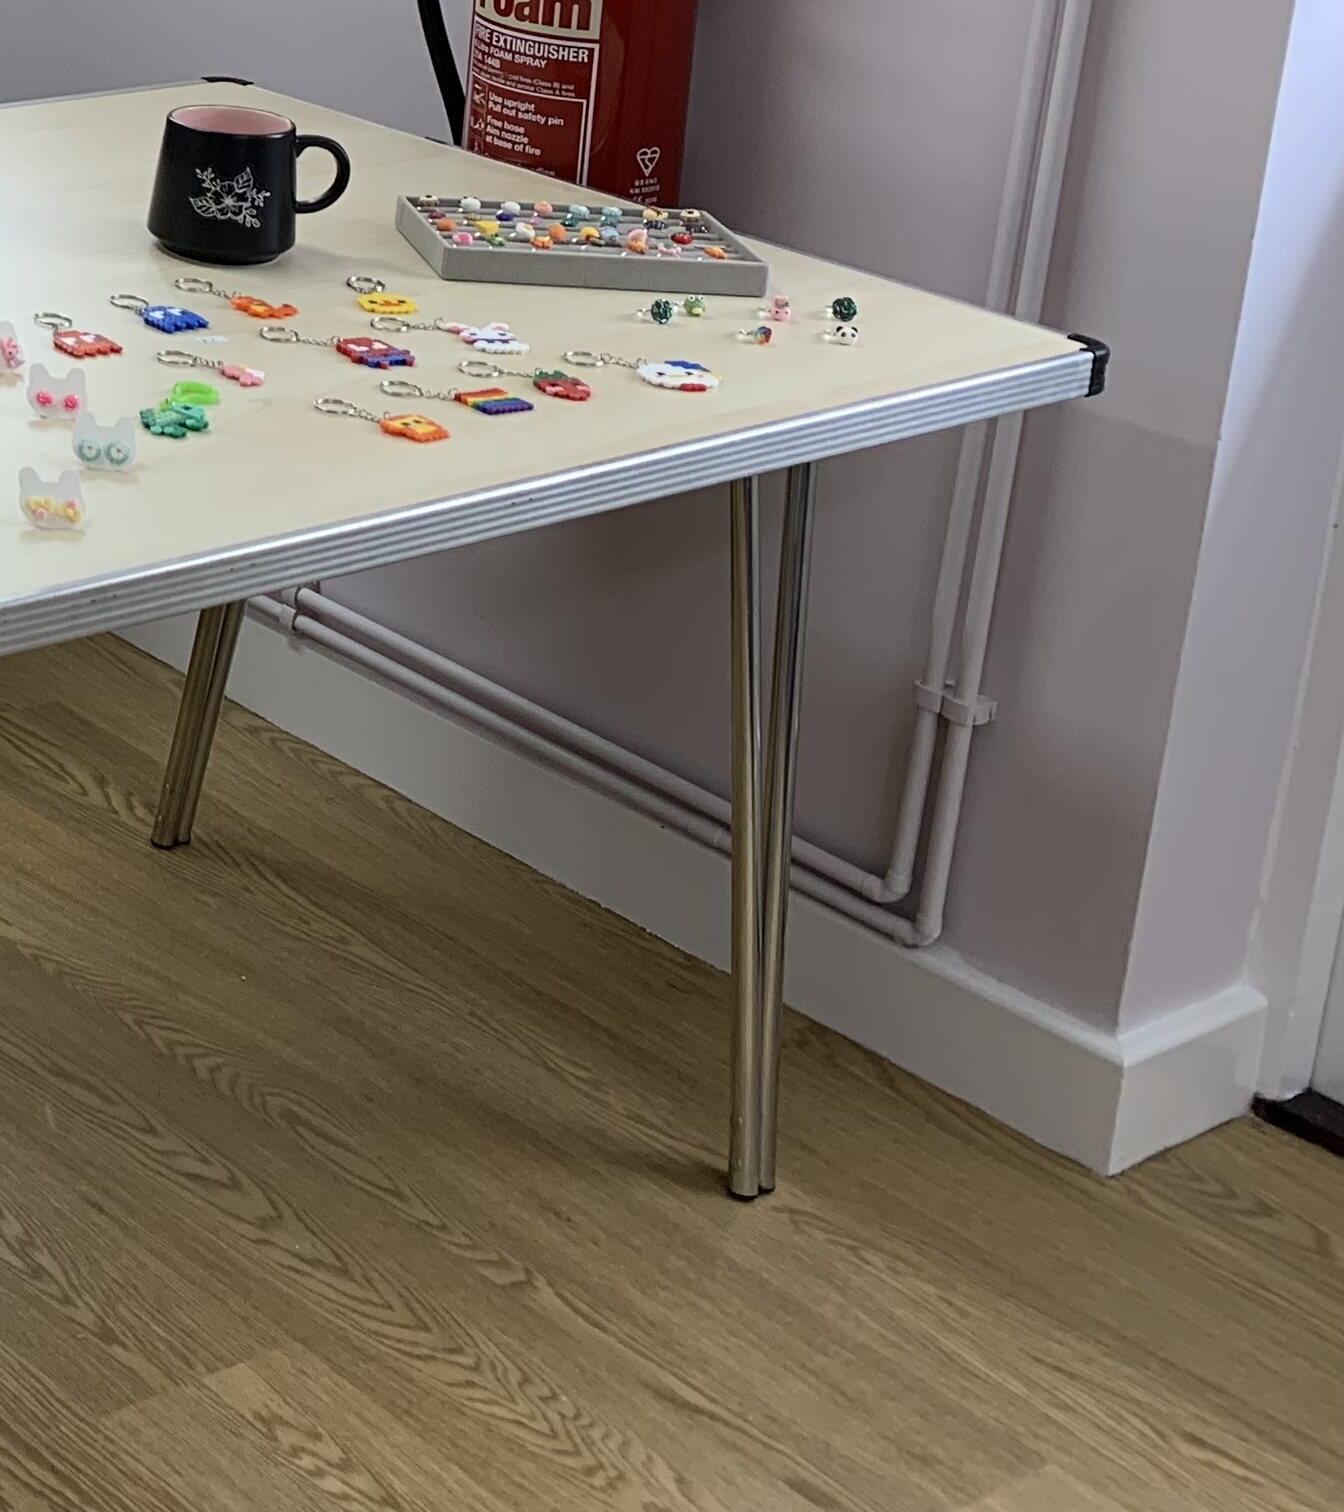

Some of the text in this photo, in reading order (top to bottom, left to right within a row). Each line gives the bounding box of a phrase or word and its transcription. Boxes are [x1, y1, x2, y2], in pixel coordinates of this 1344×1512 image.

[489, 46, 513, 61] FOAM
[513, 54, 547, 68] SPRAY
[492, 31, 589, 63] EXTINGUISHER
[488, 91, 535, 112] Use upright
[488, 101, 564, 126] Pull out safety pin
[486, 124, 529, 144] Aim nozzle
[487, 115, 525, 134] Free hose
[485, 135, 542, 156] at base of fire
